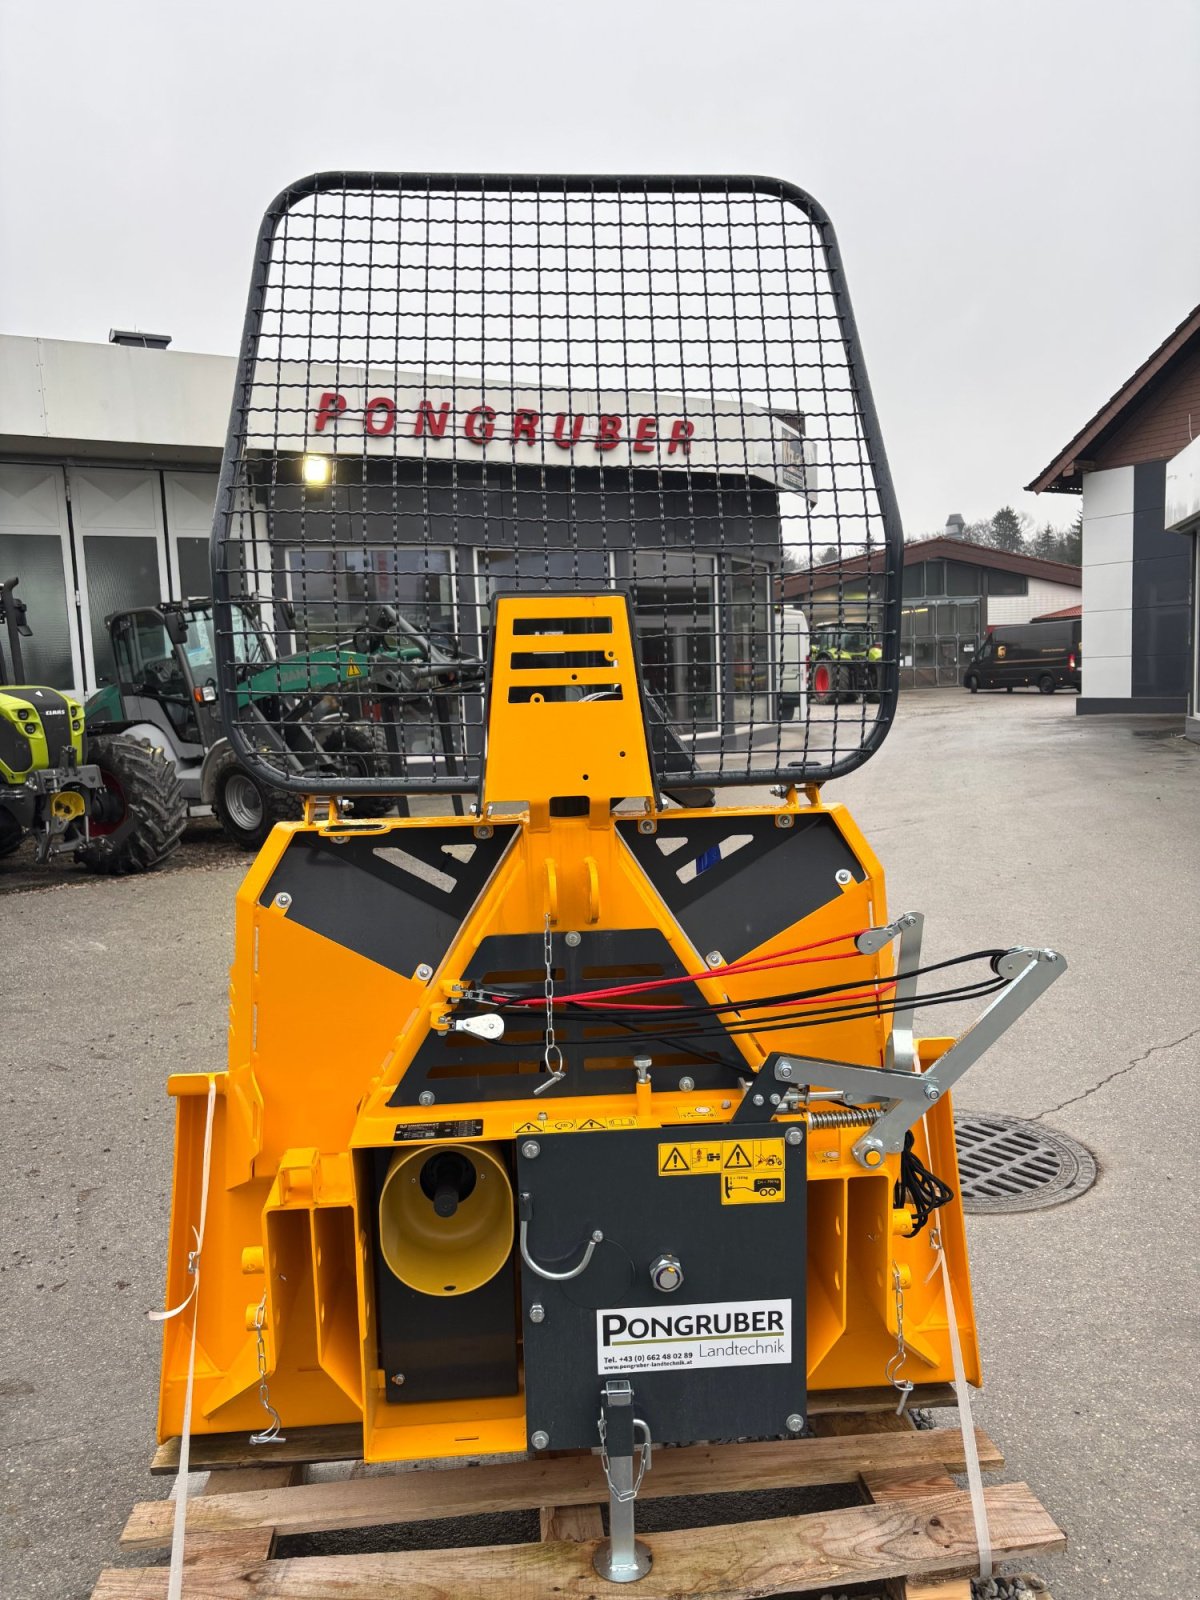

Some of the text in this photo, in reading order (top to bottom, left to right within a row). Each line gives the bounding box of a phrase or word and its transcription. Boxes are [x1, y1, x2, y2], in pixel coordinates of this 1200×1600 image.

[315, 392, 695, 454] PONGRUBER
[602, 1311, 784, 1347] PONGRUBER
[603, 1356, 618, 1364] Tel.
[618, 1355, 633, 1363] +43
[634, 1354, 645, 1363] (0)
[683, 1351, 693, 1359] 89
[699, 1339, 785, 1358] Landtechnik
[603, 1360, 693, 1370] www.pongruber-landtechnik.at
